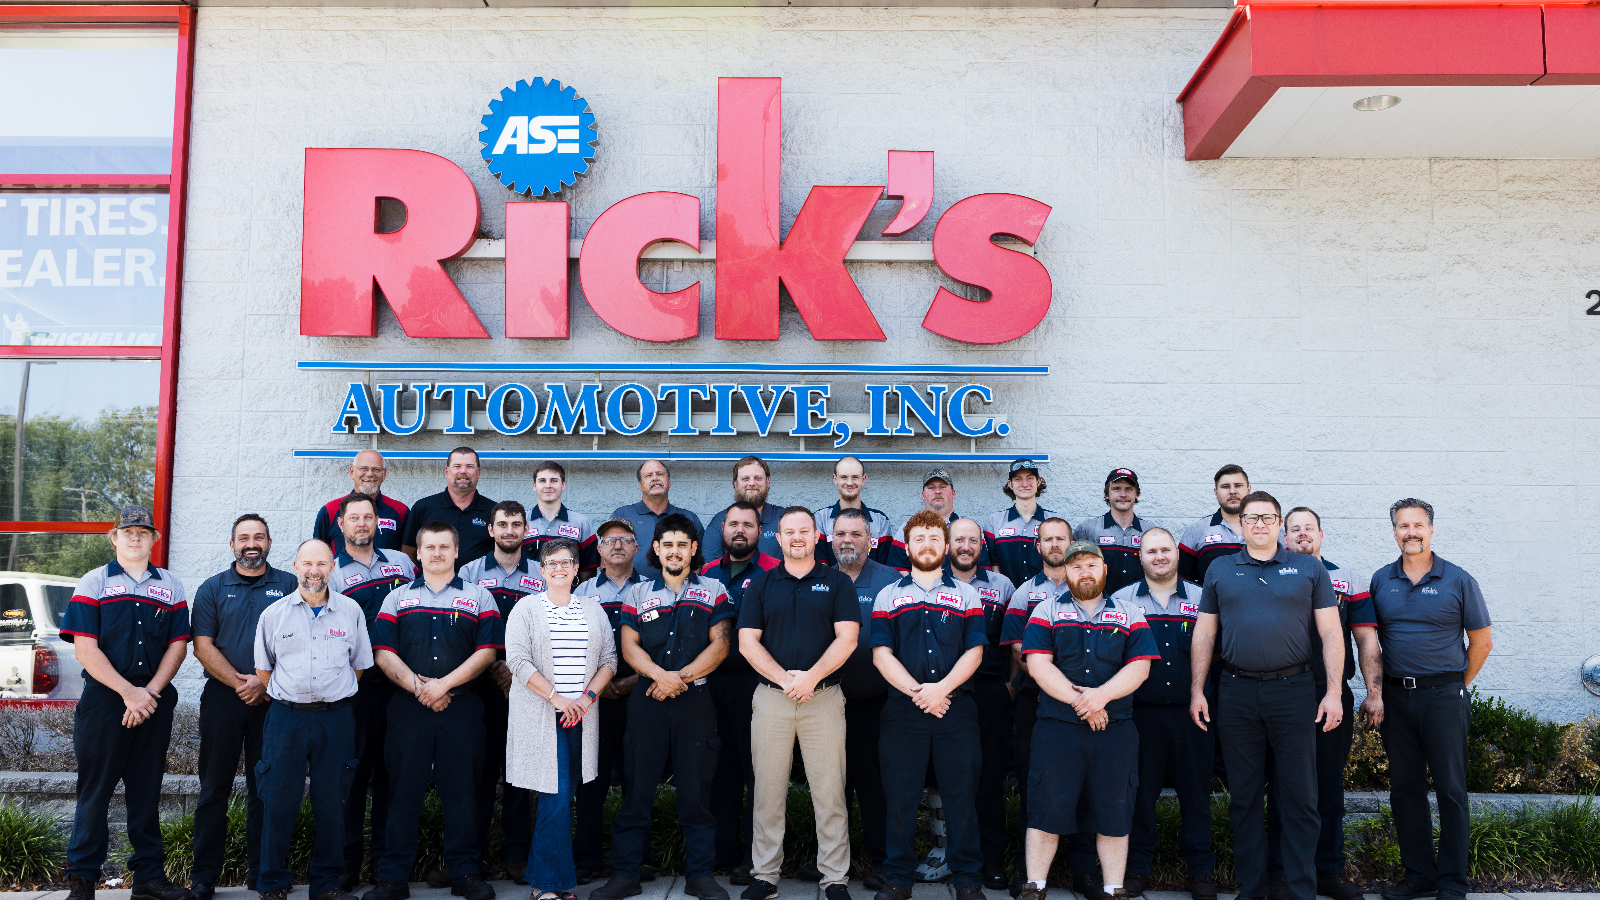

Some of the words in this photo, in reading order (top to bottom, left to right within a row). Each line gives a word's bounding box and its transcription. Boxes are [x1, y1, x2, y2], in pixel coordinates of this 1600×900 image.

[491, 115, 580, 154] ASE
[300, 76, 1053, 344] Rick's
[20, 197, 169, 236] TIRES.
[34, 331, 157, 346] MICHELIN
[330, 381, 852, 448] AUTOMOTIVE,
[864, 383, 1011, 438] INC.
[561, 527, 578, 536] Rick's
[524, 579, 540, 588] Rick's
[150, 588, 170, 599] Rick's
[981, 590, 997, 598] Rick's
[456, 599, 474, 608] Rick's
[941, 595, 959, 604] Rick's
[1105, 612, 1124, 621] Rick's
[329, 628, 346, 636] Rick's
